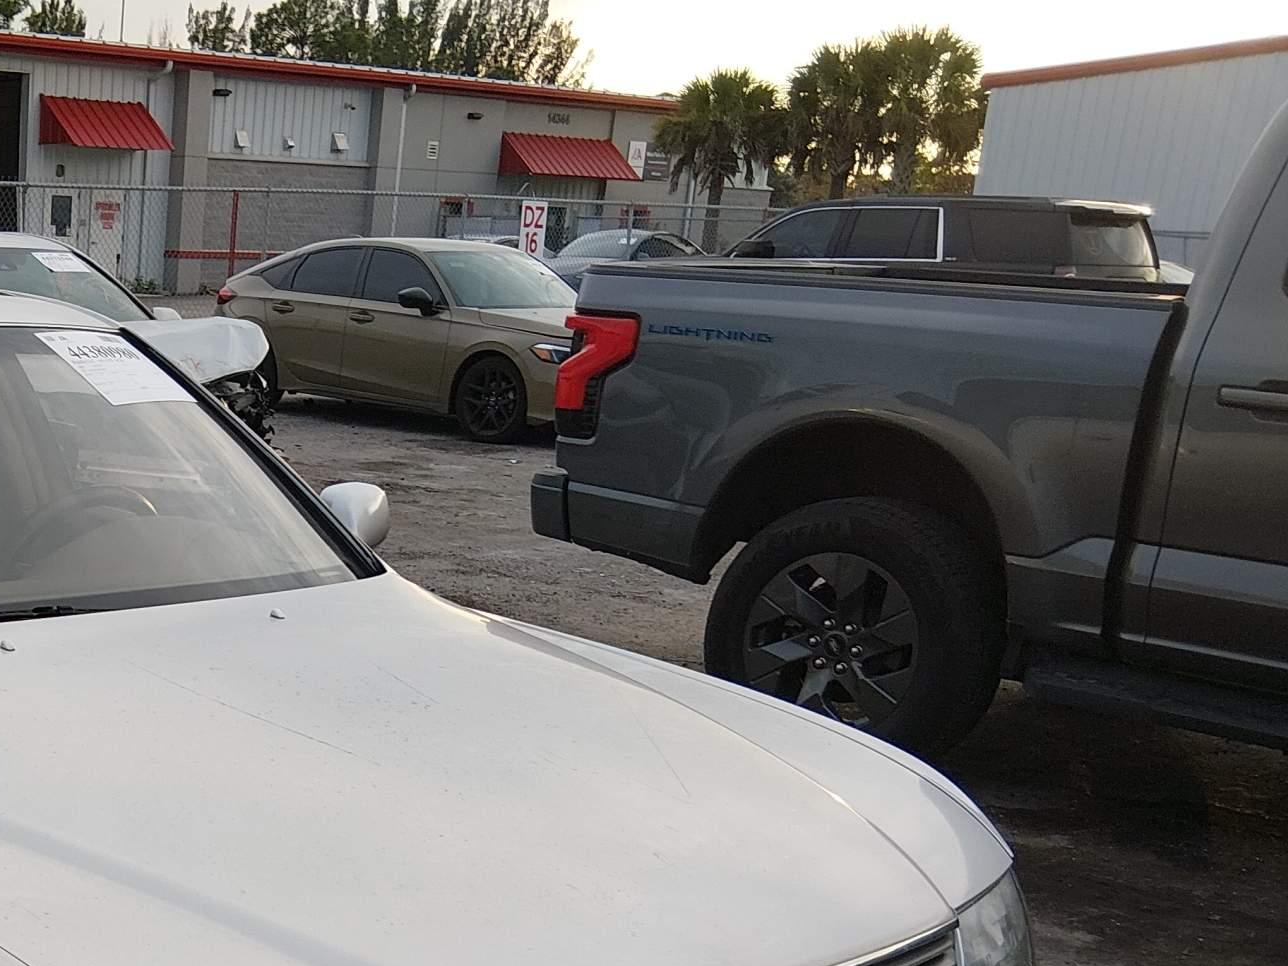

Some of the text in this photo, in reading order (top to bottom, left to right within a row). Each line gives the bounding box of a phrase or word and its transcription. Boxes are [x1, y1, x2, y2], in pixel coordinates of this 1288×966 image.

[523, 205, 545, 228] DZ
[525, 232, 538, 253] 16
[648, 324, 773, 343] LIGHTNING
[67, 345, 140, 361] 44380980
